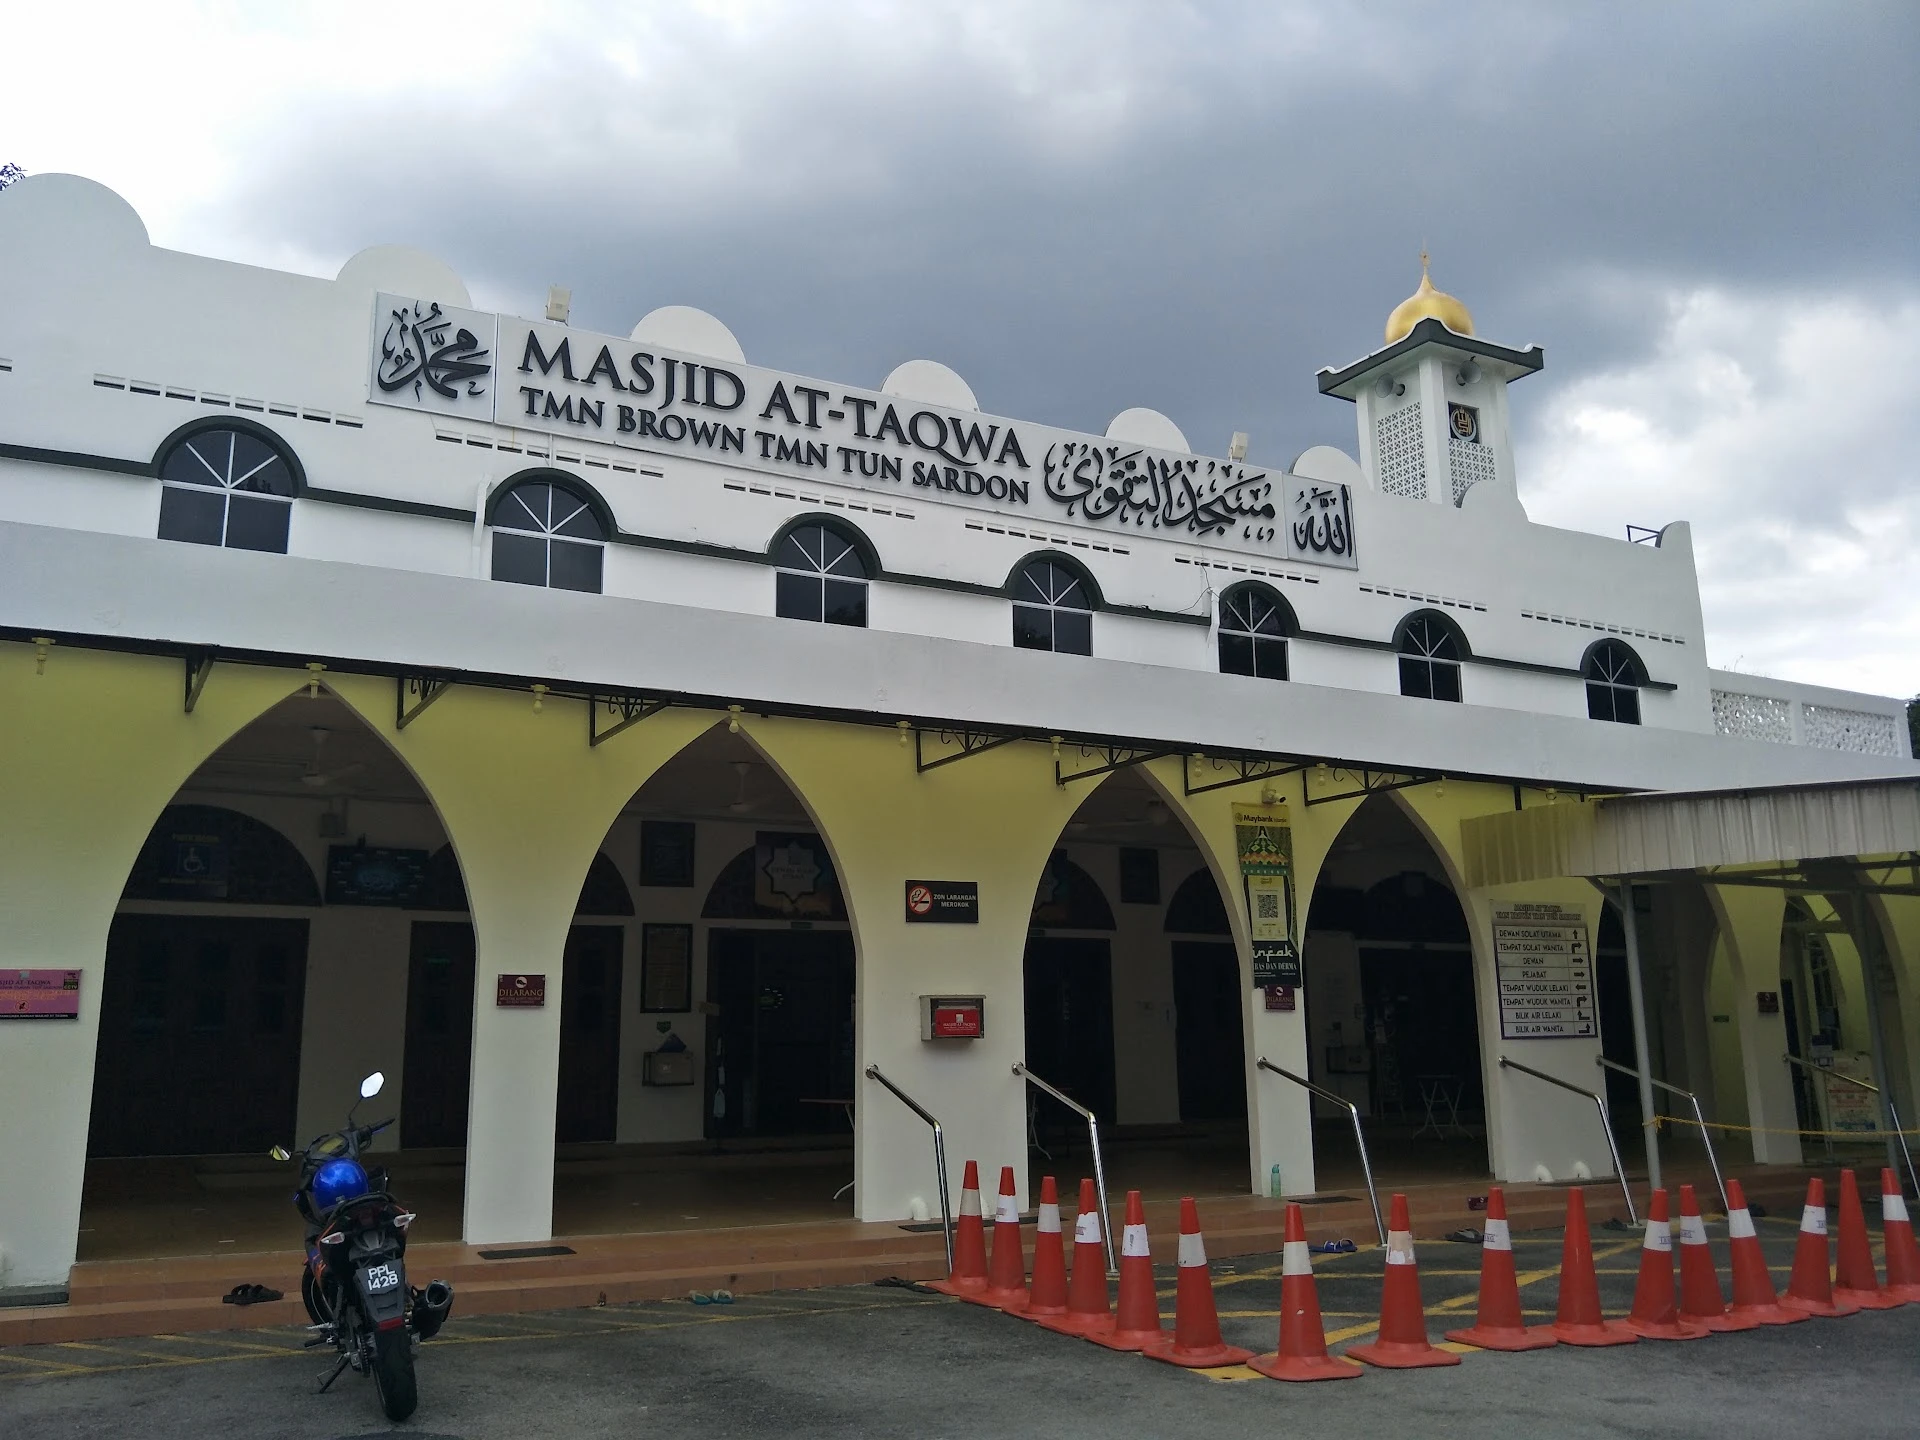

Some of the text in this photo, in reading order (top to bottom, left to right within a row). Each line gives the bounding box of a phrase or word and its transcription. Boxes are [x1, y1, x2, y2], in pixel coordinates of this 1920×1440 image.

[518, 329, 1031, 468] MASJID AT-TAQWA
[519, 385, 1030, 505] TMN BROWN TMN TUN SARDON
[1243, 815, 1273, 823] Maybank
[1499, 930, 1520, 938] DEWAN
[1500, 943, 1522, 951] TEMPAT
[368, 1264, 396, 1280] PPL
[368, 1274, 398, 1291] 1428
